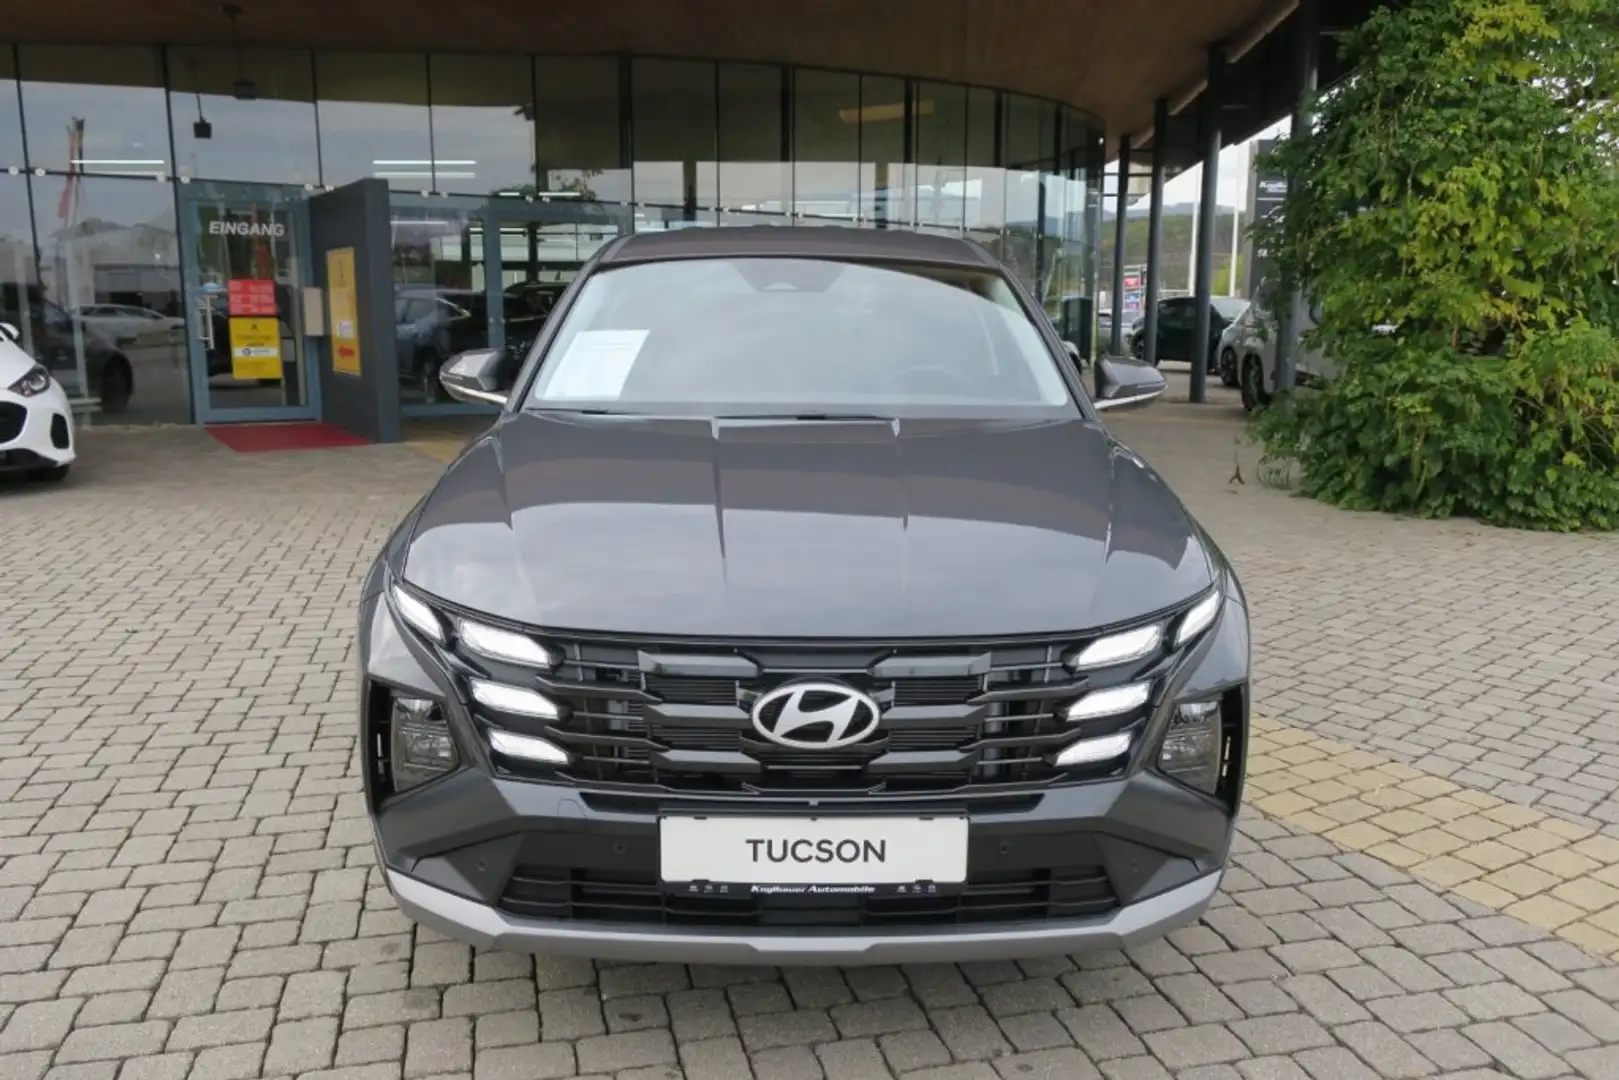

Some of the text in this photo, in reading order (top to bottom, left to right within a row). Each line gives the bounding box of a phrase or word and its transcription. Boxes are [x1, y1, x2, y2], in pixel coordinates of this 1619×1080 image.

[208, 219, 286, 238] EINGANG
[745, 838, 887, 863] TUCSON
[807, 884, 876, 894] Automobile
